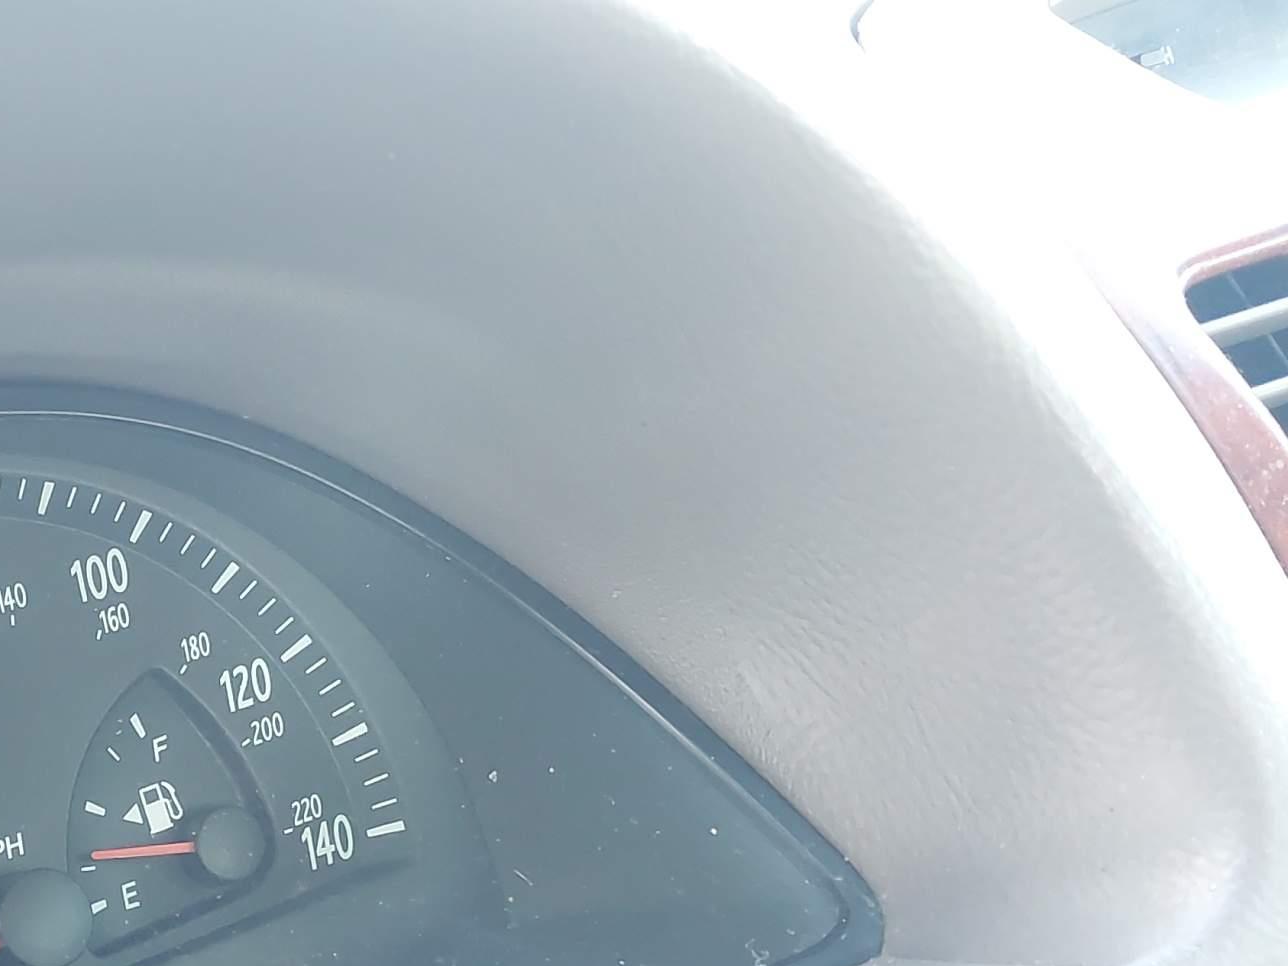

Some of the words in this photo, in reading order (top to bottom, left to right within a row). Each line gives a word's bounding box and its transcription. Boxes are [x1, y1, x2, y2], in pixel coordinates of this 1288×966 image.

[69, 547, 130, 604] 100
[99, 604, 130, 634] 160
[180, 632, 212, 662] 180
[219, 657, 272, 713] 120
[250, 711, 285, 743] 200
[152, 736, 168, 763] F
[290, 793, 324, 825] 220
[300, 815, 354, 870] 140
[123, 882, 141, 912] E
